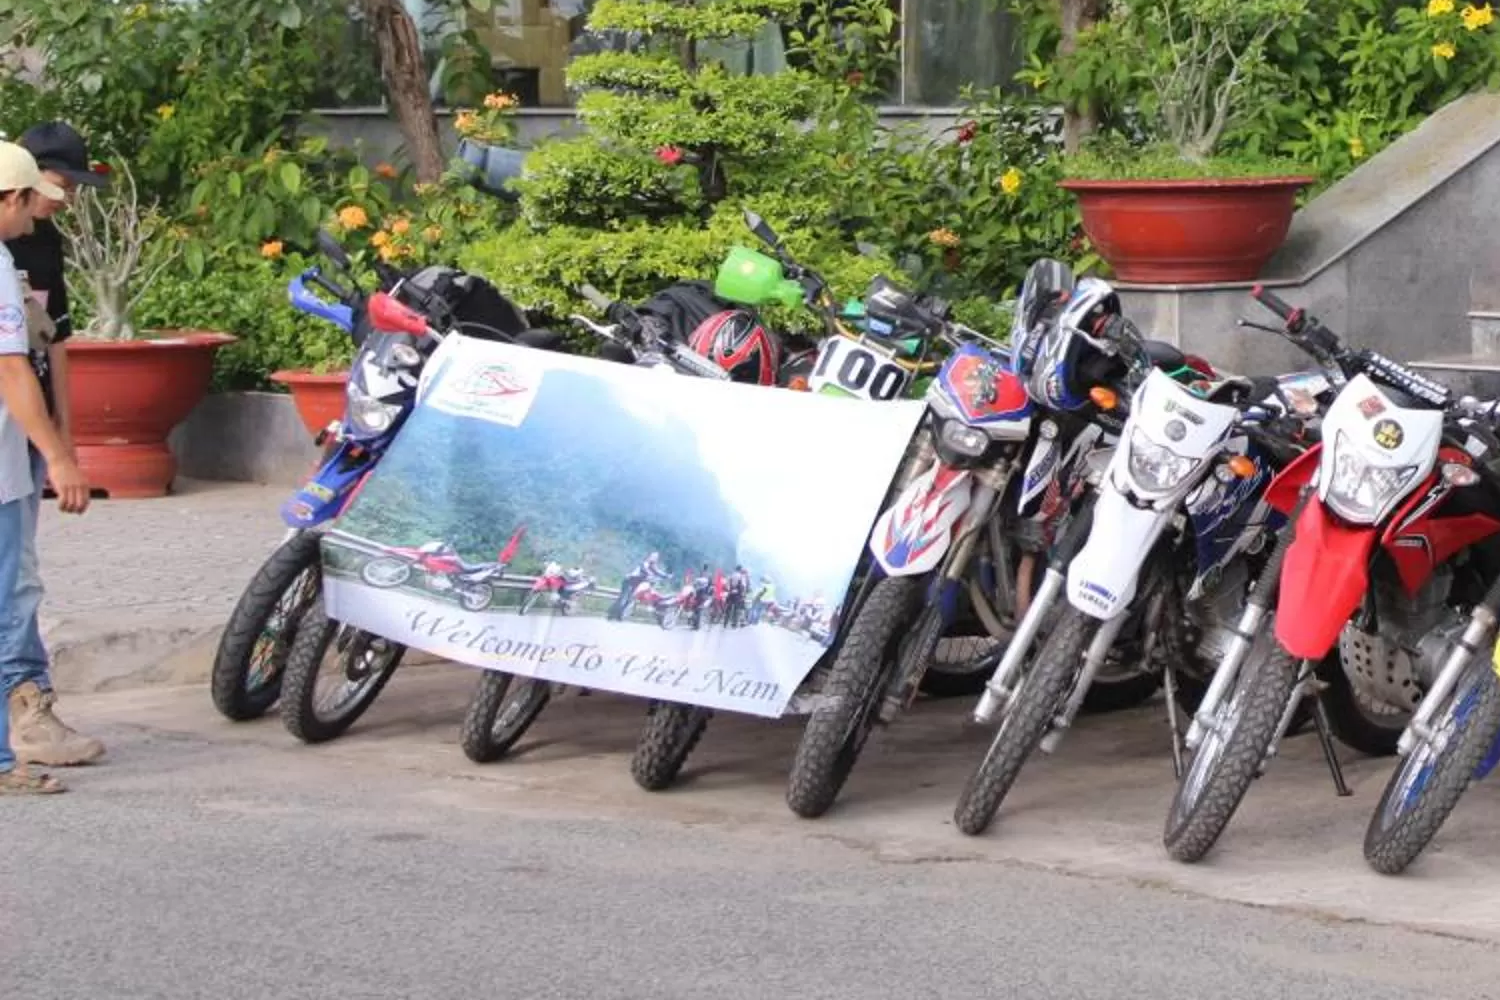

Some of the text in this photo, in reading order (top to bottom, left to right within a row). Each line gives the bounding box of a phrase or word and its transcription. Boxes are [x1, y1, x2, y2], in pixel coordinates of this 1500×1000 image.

[815, 339, 906, 401] 100
[404, 607, 780, 701] Welcome To Viet Nam
